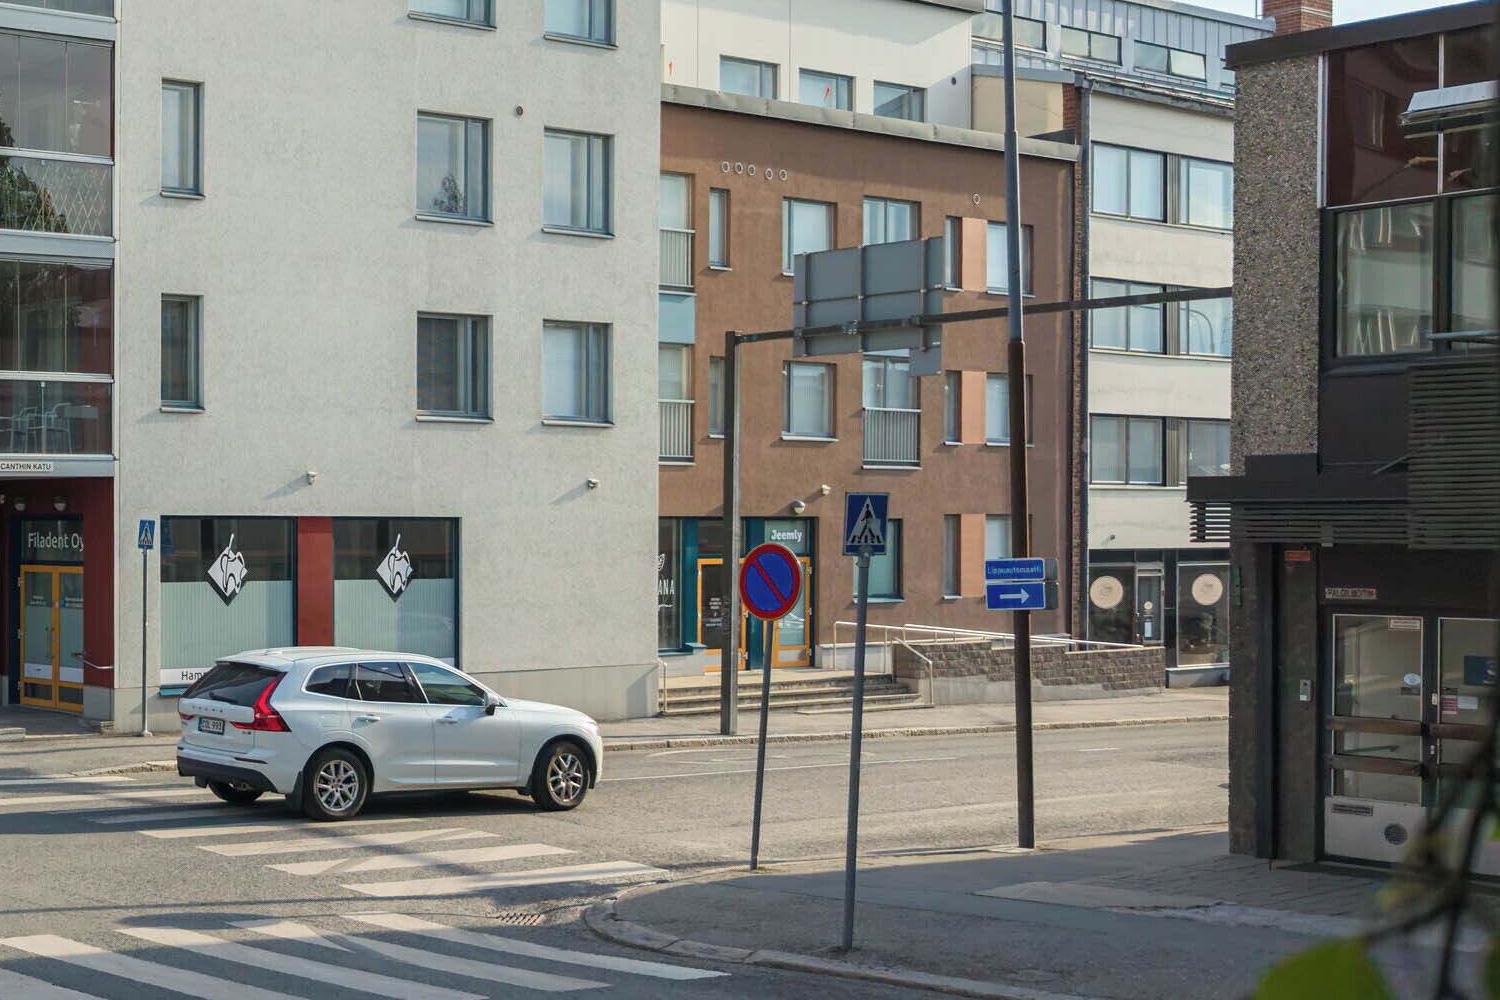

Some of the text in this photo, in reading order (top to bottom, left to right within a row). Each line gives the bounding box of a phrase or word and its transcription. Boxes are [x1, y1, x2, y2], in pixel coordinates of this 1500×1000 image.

[0, 462, 31, 471] CANTHIN
[32, 462, 52, 471] KATU
[27, 531, 69, 549] Filadent
[181, 671, 207, 681] Ham
